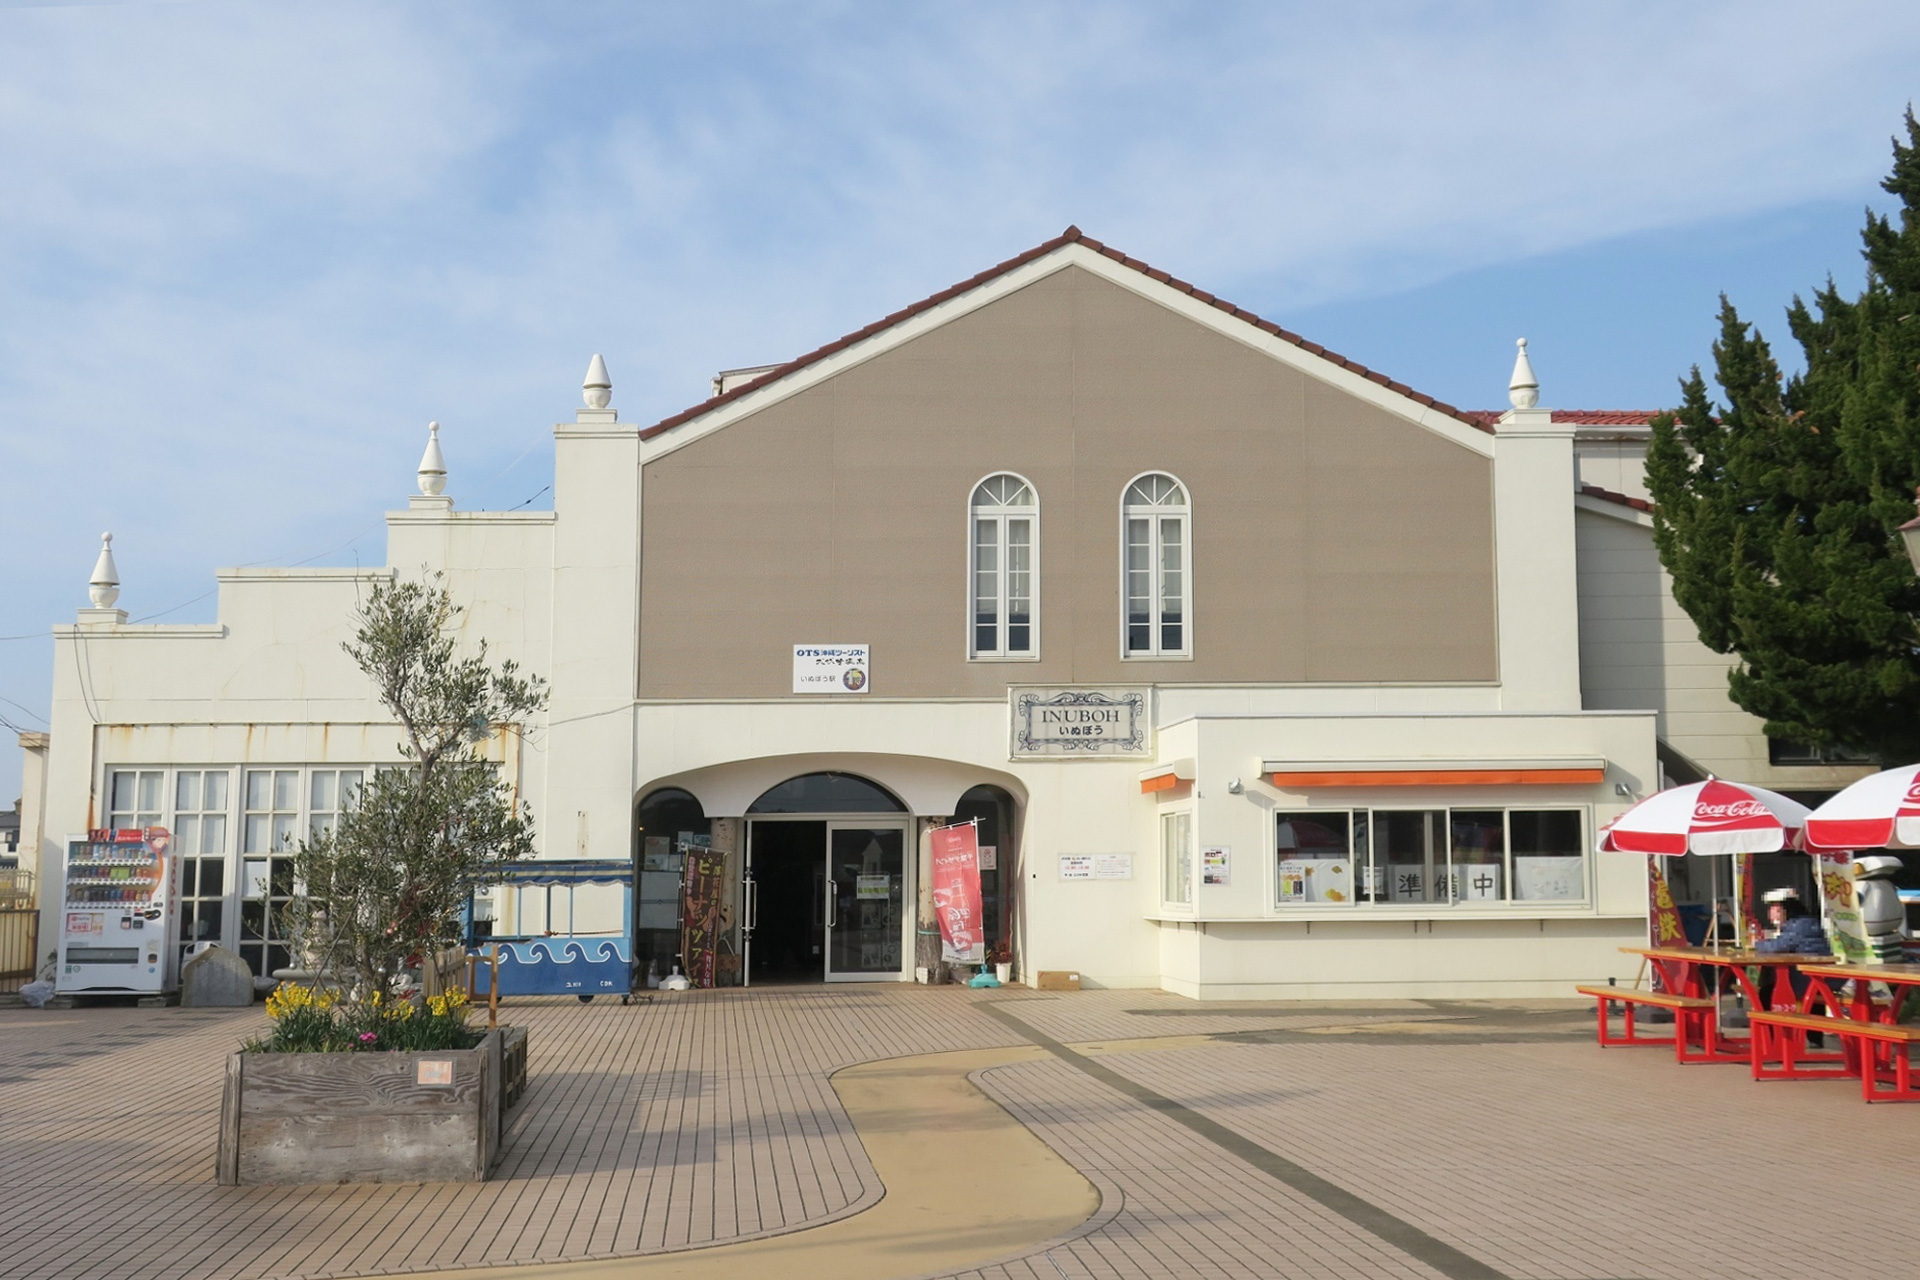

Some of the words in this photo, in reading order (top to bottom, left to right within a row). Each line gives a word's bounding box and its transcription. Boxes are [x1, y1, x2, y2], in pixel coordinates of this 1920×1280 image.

[1041, 709, 1120, 723] INUBOH
[1059, 725, 1104, 736] いぬぼう
[1693, 799, 1771, 818] Coca-Cola
[1398, 873, 1494, 898] 準備中
